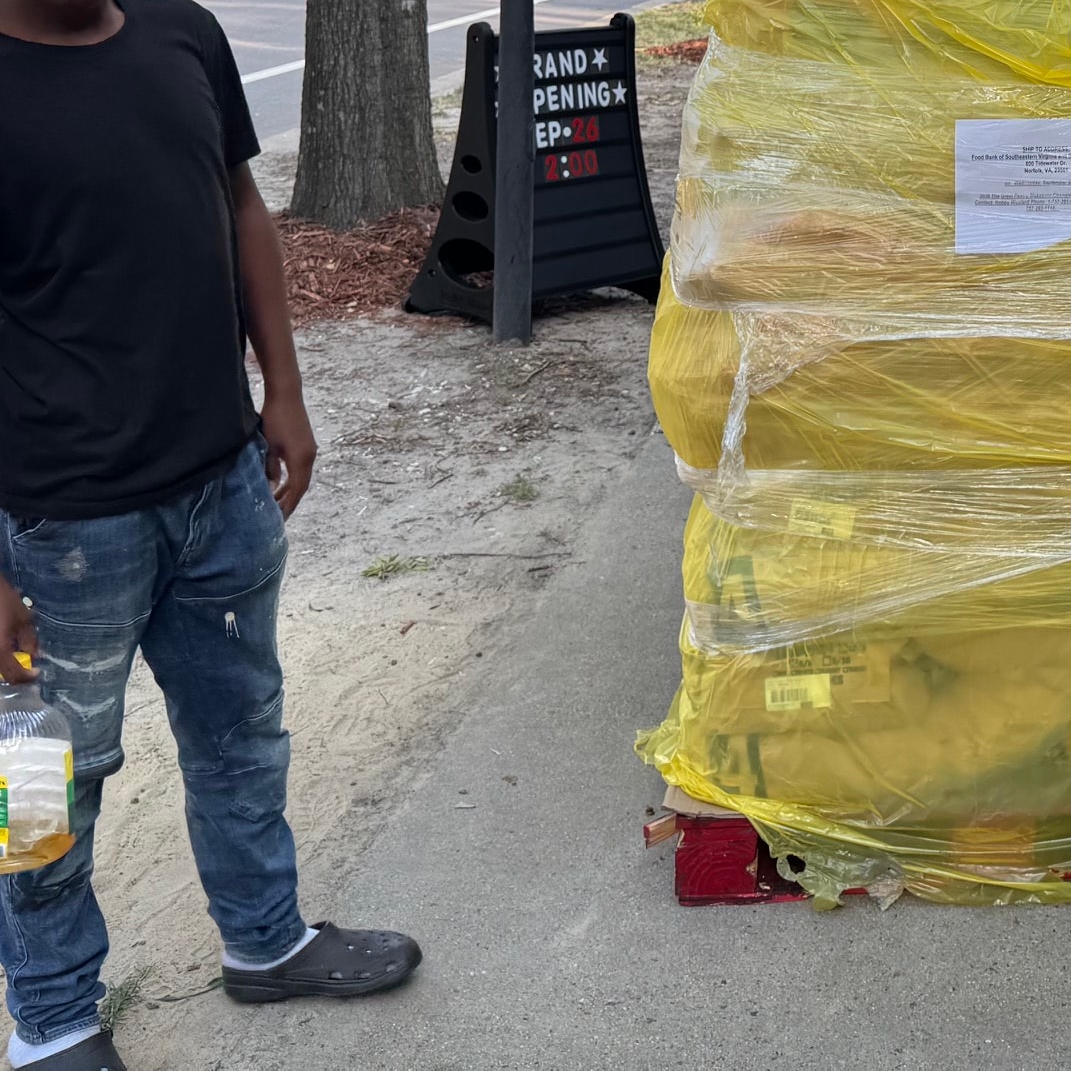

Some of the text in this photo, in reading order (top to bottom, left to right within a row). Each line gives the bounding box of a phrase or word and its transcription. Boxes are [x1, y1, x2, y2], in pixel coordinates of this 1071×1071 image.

[533, 49, 587, 79] RAND
[533, 81, 611, 115] PENING
[545, 149, 598, 181] 2:00
